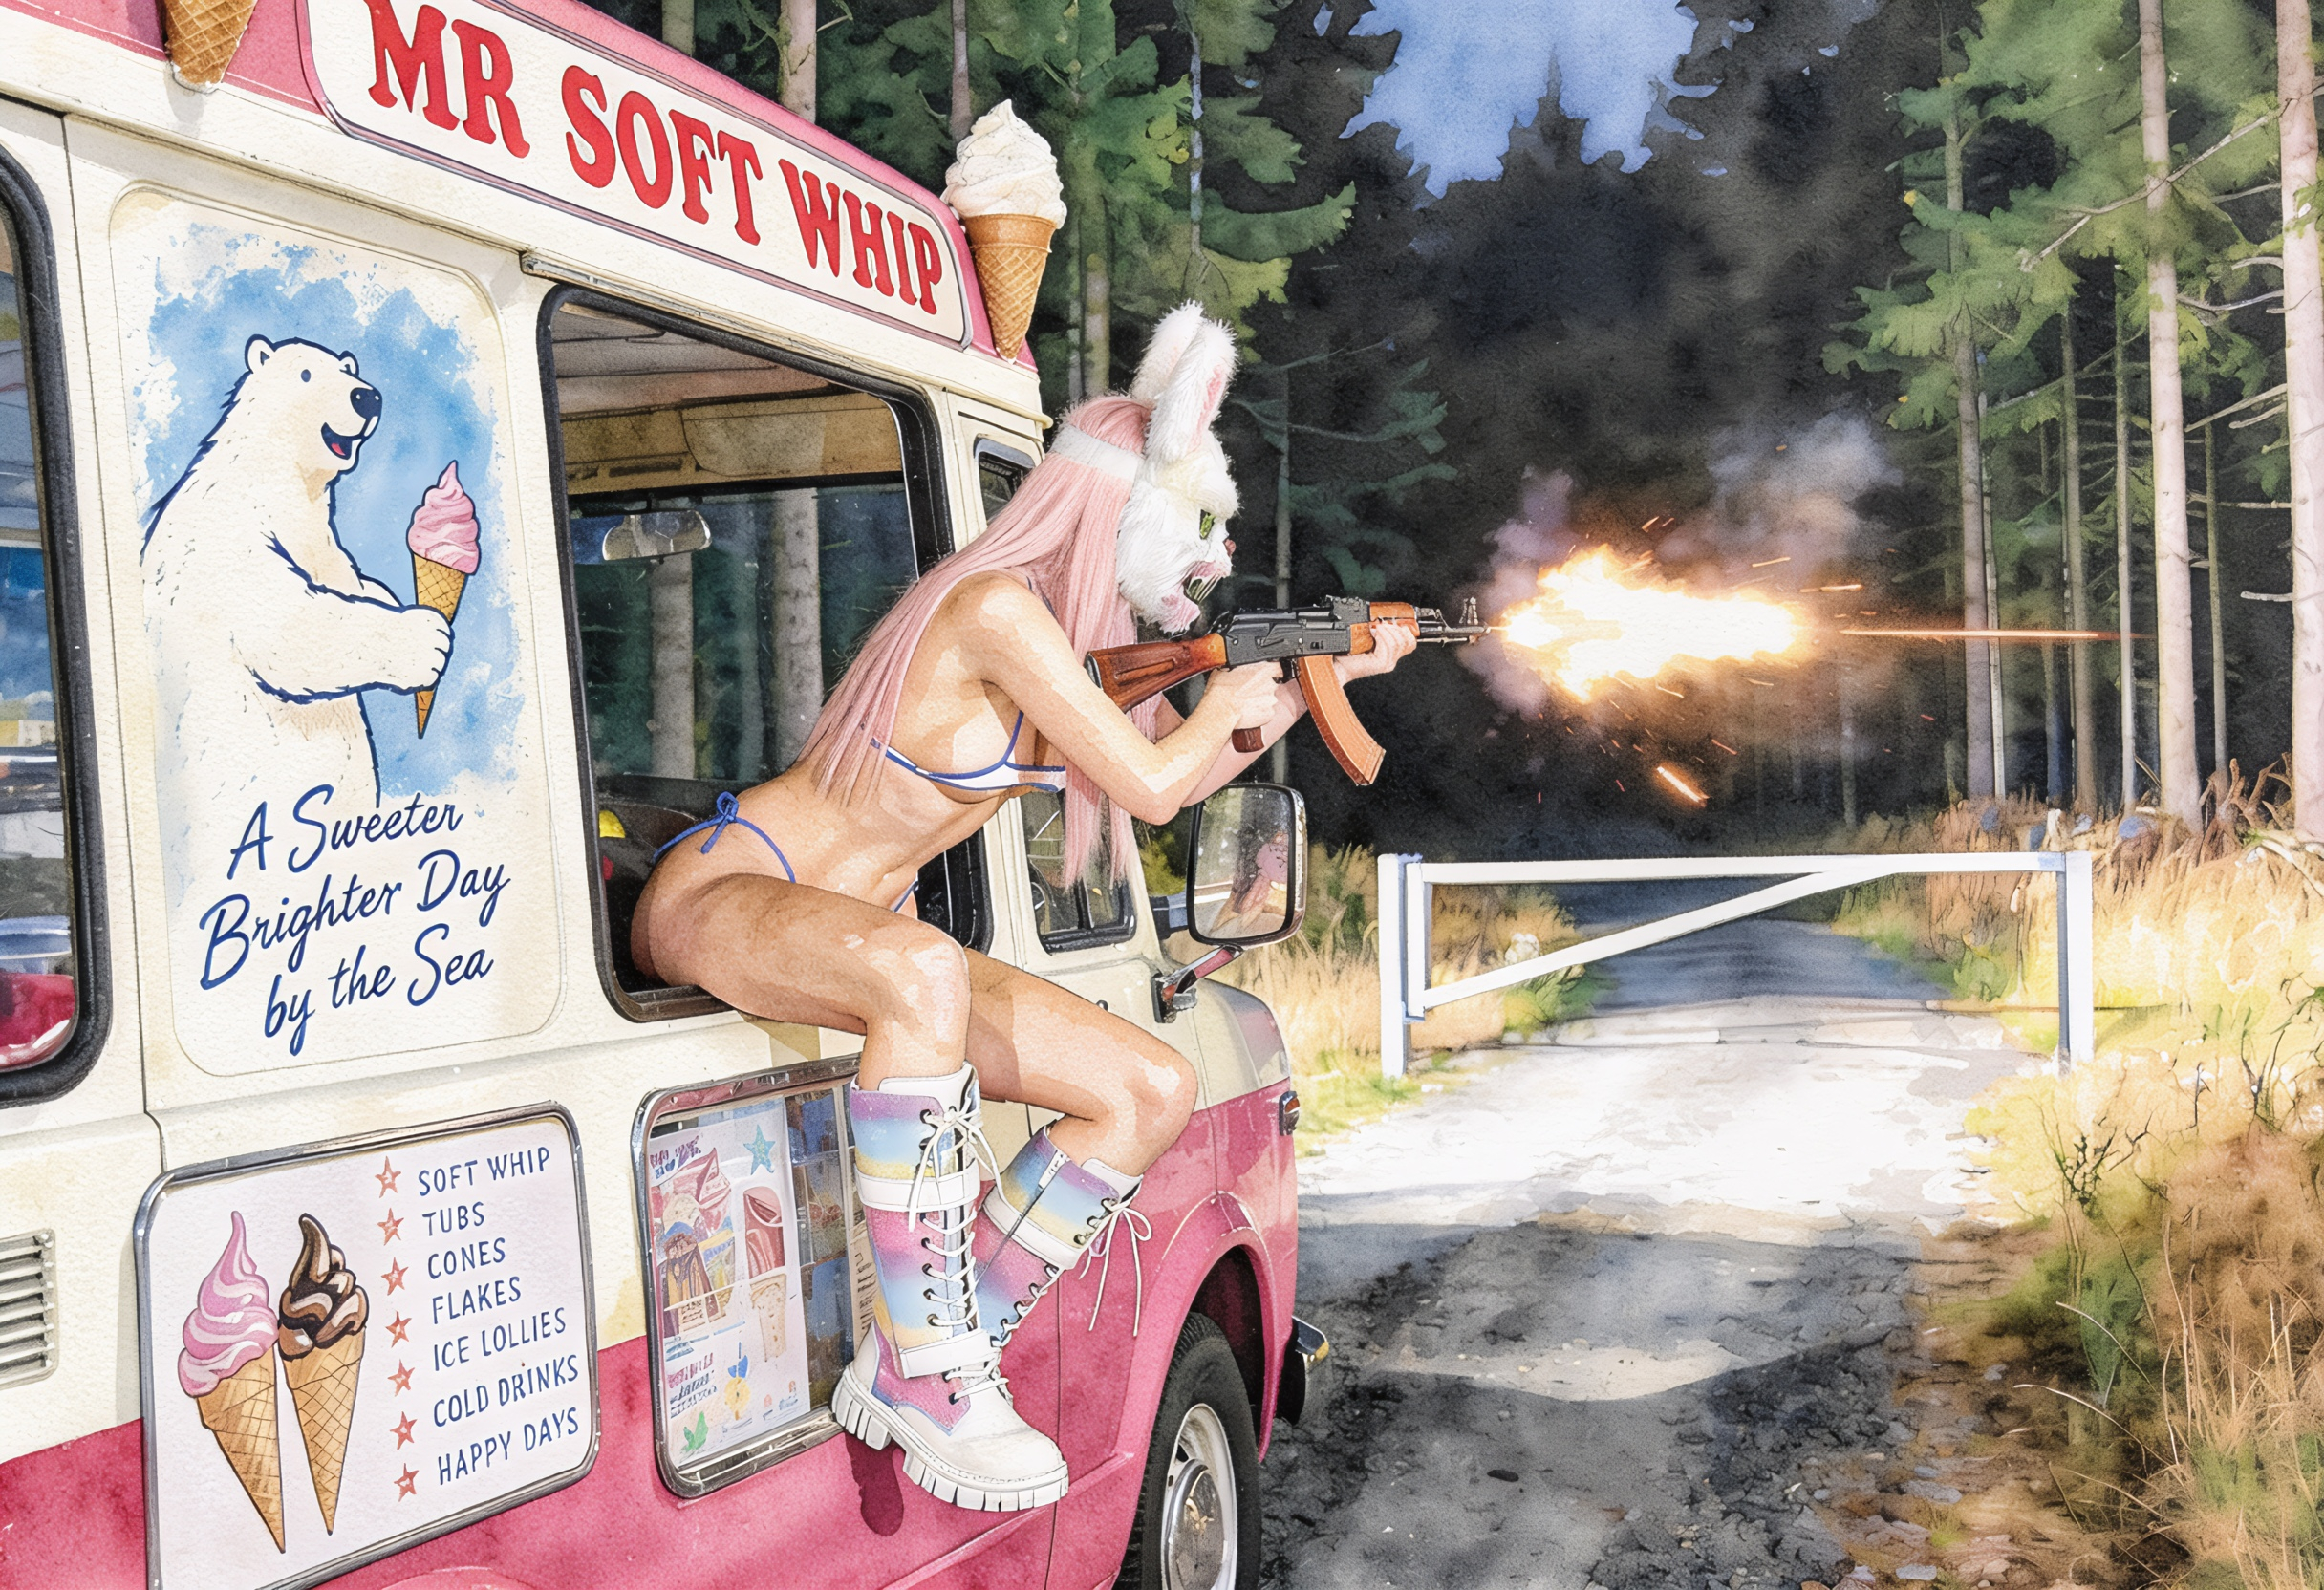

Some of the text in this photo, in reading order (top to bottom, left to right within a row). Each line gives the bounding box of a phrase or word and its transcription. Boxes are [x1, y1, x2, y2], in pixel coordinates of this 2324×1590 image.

[364, 0, 941, 315] MR SOFT WHIP
[226, 784, 463, 880] A Sweeter
[199, 849, 511, 990] Brighter Day
[264, 923, 494, 1056] by the Sea
[418, 1147, 550, 1196] SOFT WHIP
[422, 1201, 485, 1236] TUBS
[427, 1237, 506, 1280] CONES
[432, 1276, 522, 1324] FLAKES
[434, 1306, 567, 1371] ICE LOLLIES
[433, 1354, 579, 1428] COLD DRINKS
[438, 1407, 579, 1485] HAPPY DAYS
